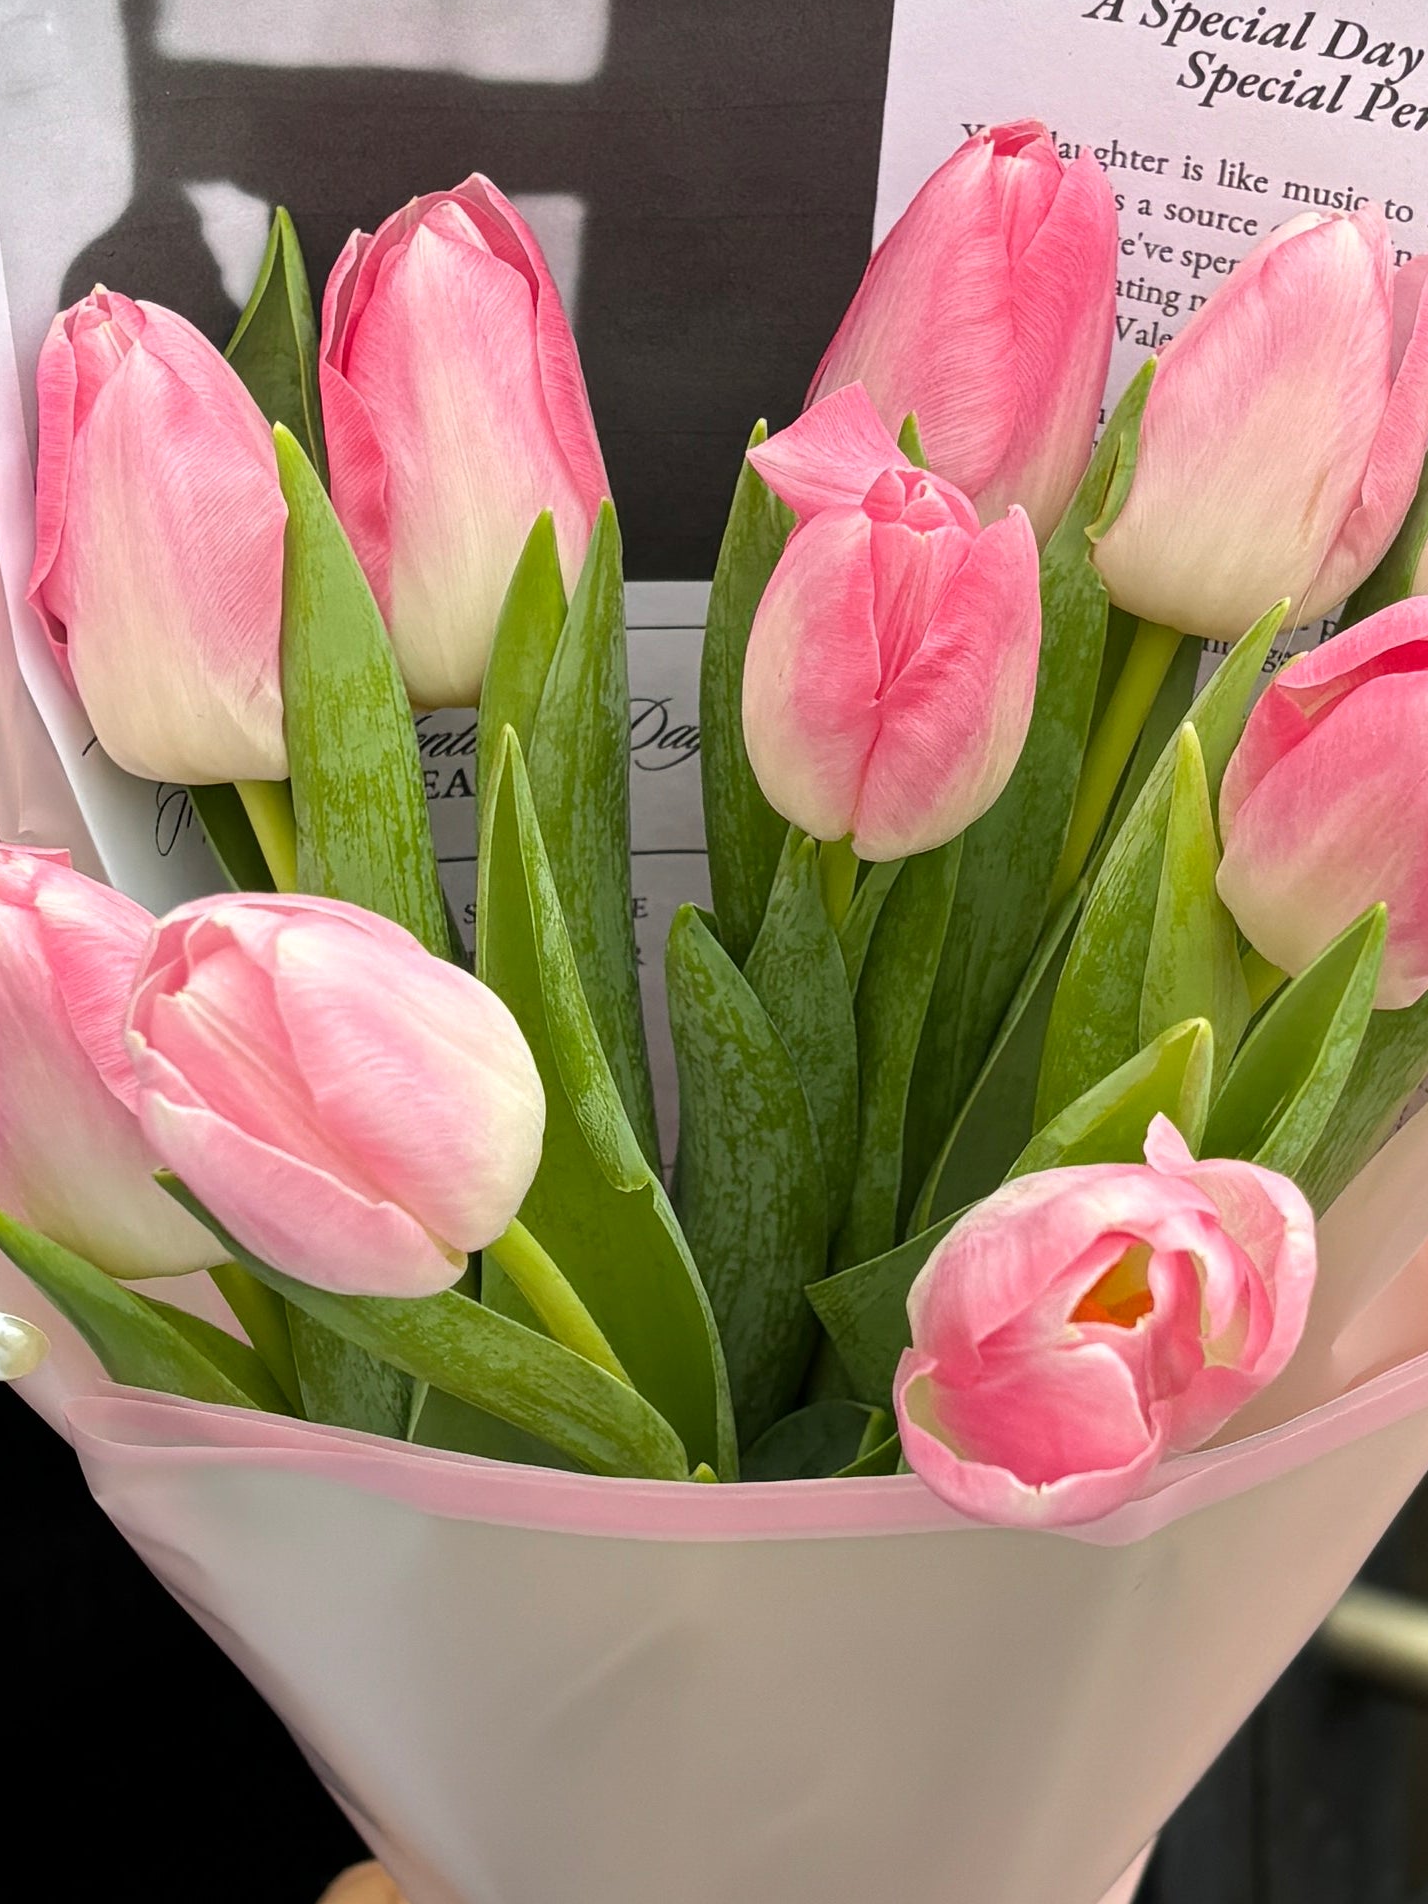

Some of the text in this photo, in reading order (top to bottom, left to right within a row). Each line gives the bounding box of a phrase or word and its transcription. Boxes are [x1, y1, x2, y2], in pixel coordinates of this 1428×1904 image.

[1176, 49, 1352, 114] Special
[1317, 18, 1426, 84] Day
[1136, 197, 1154, 217] a
[1162, 201, 1259, 237] source
[1181, 154, 1205, 183] is
[1217, 157, 1270, 195] like
[1280, 180, 1369, 215] music
[1383, 197, 1415, 224] to
